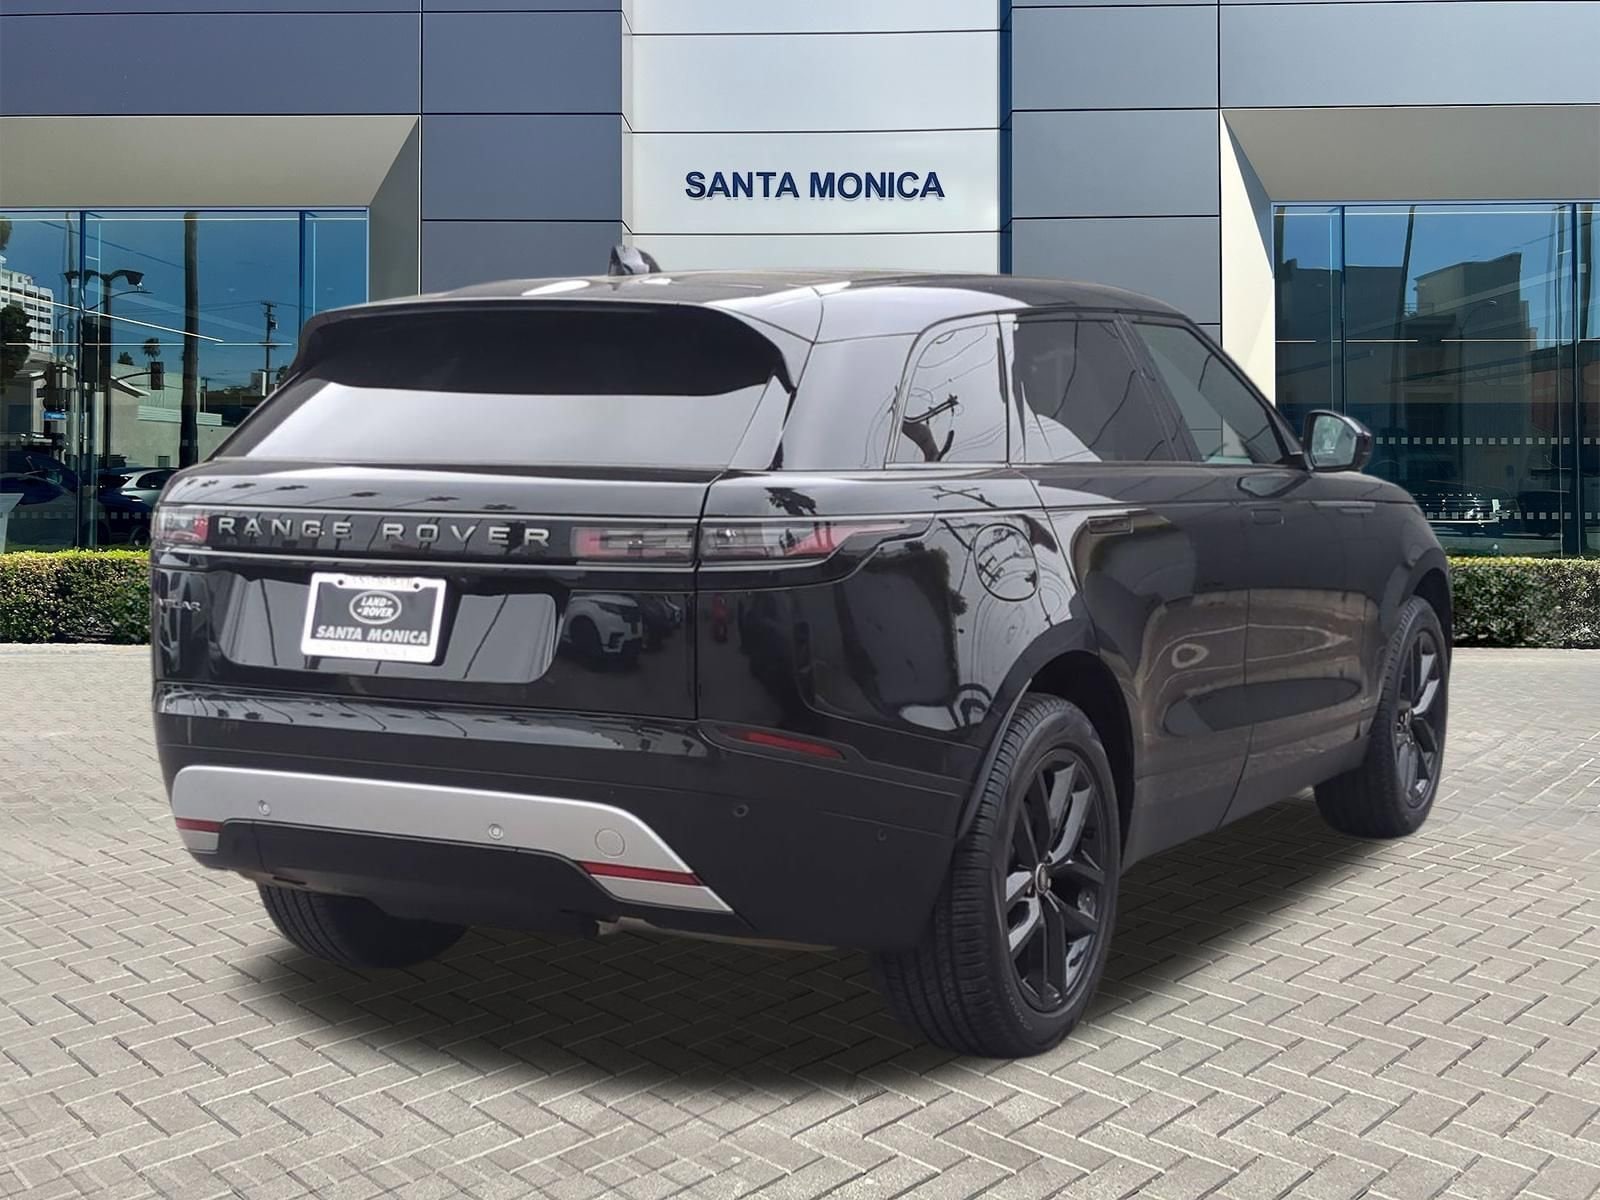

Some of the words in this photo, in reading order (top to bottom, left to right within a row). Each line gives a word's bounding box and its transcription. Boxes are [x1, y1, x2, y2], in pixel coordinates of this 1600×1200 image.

[685, 171, 800, 199] SANTA
[809, 171, 945, 199] MONICA
[218, 517, 351, 539] RANGE
[383, 523, 550, 548] ROVER
[360, 596, 388, 607] LAND
[362, 607, 394, 618] ROVER
[316, 625, 363, 640] SANTA
[367, 628, 428, 645] MONICA
